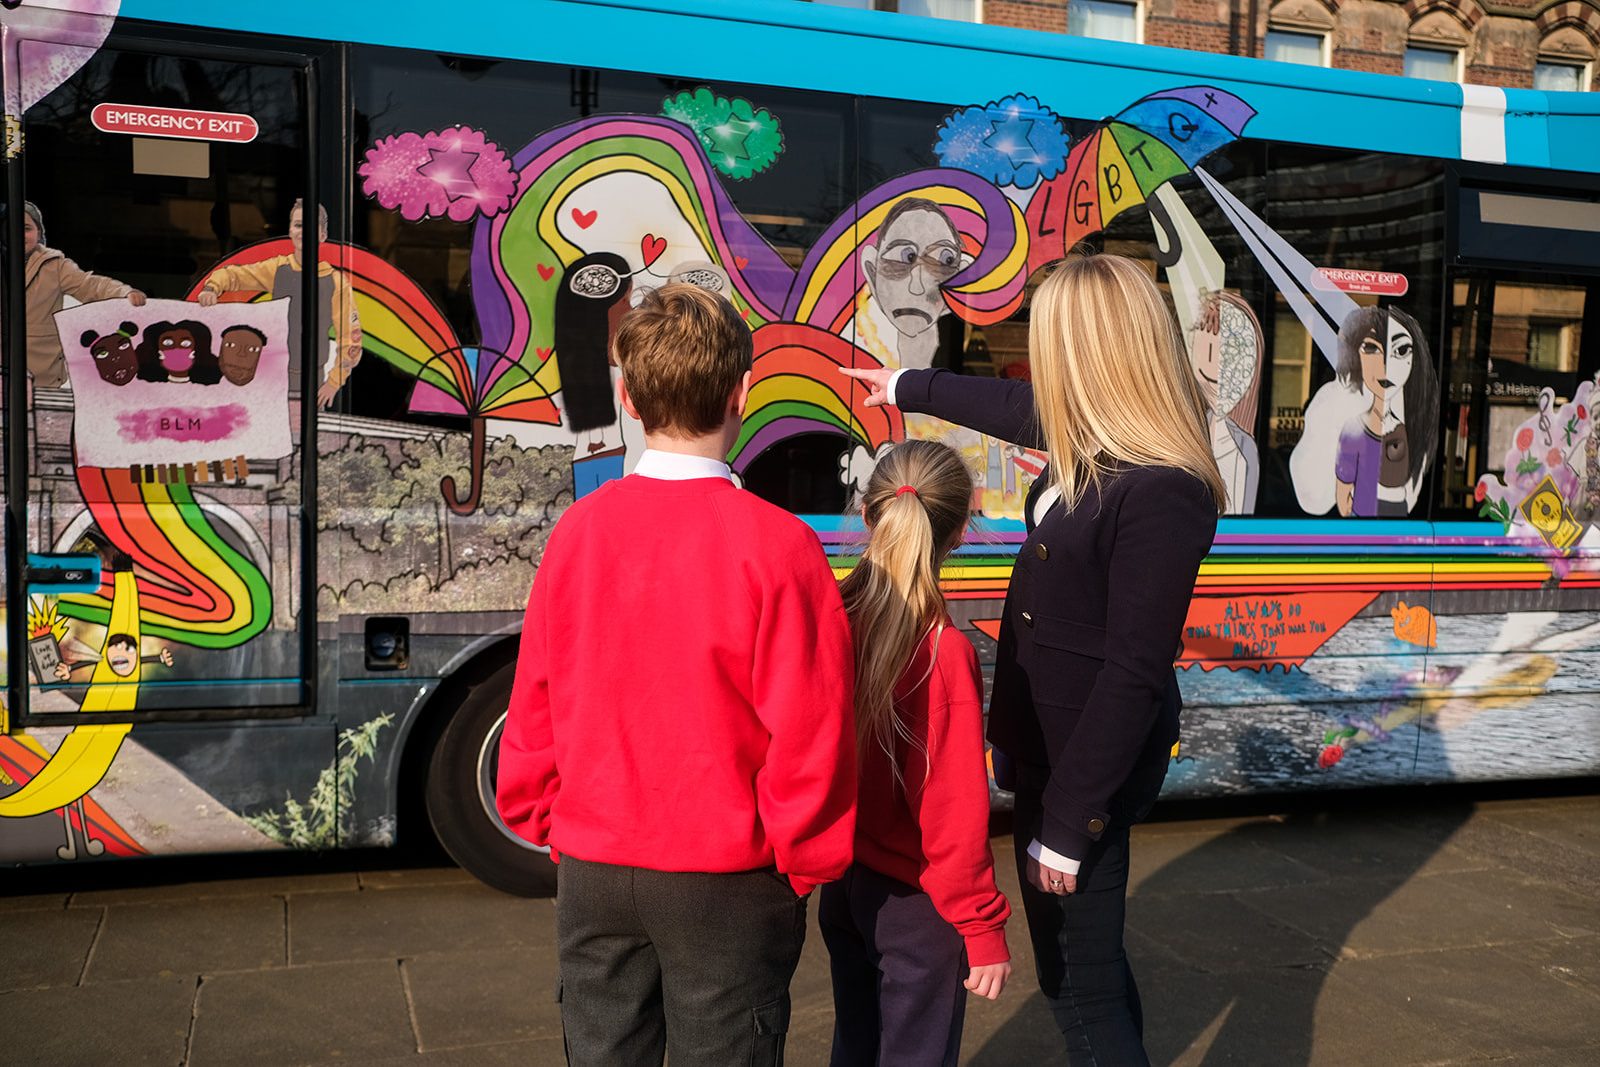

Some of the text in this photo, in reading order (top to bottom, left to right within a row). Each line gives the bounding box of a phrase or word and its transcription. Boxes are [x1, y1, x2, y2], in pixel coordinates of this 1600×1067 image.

[106, 110, 243, 134] EMERGENCY EXIT
[1320, 270, 1400, 284] EMERGENCY EXIT
[160, 418, 201, 431] BLM
[1224, 600, 1302, 620] ALWAYS DO
[1215, 622, 1257, 640] THINGS
[1261, 622, 1285, 638] THAT
[1309, 620, 1327, 633] YOU
